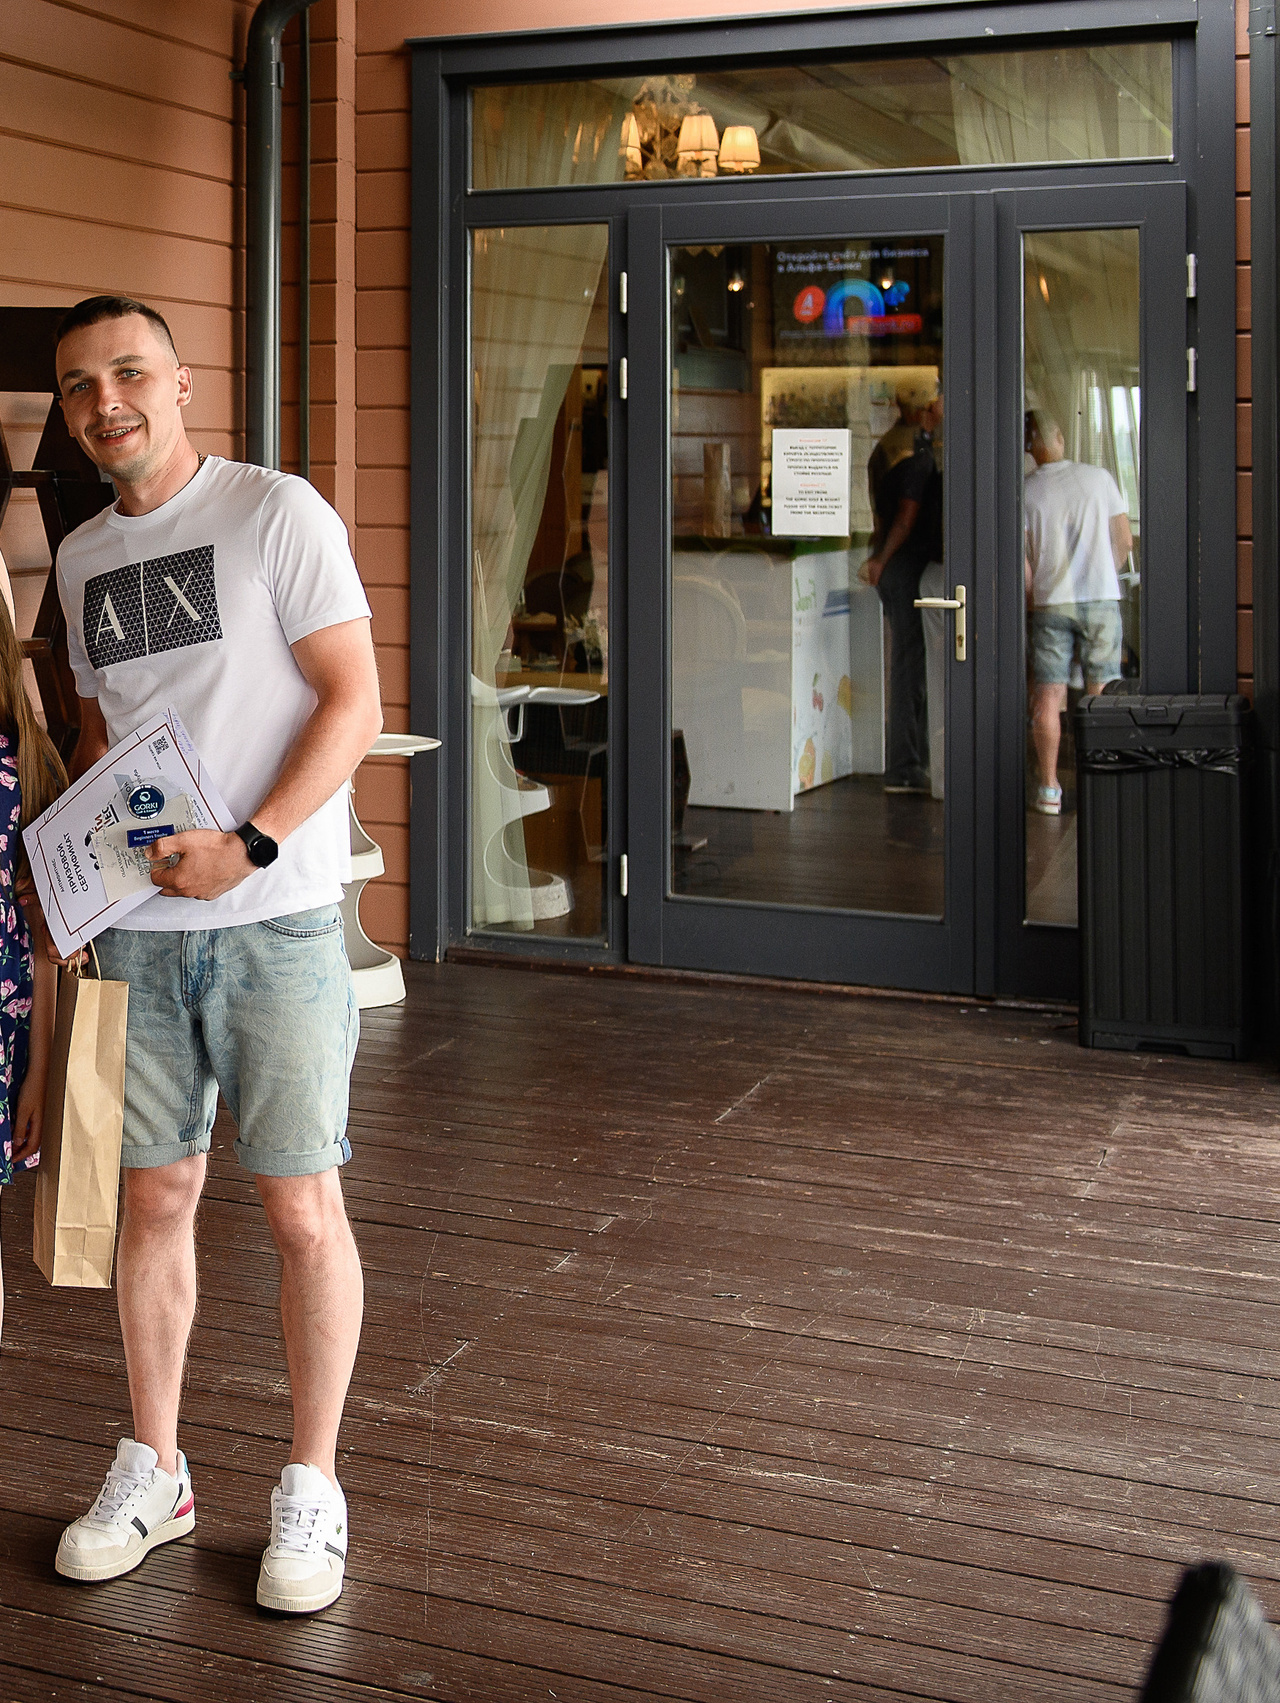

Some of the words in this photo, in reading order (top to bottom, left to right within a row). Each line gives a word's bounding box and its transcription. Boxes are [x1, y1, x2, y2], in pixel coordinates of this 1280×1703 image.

[134, 802, 159, 811] GORKI
[56, 842, 79, 894] ПРИЗОВОЙ
[63, 832, 89, 892] СЕРТИФИКАТ
